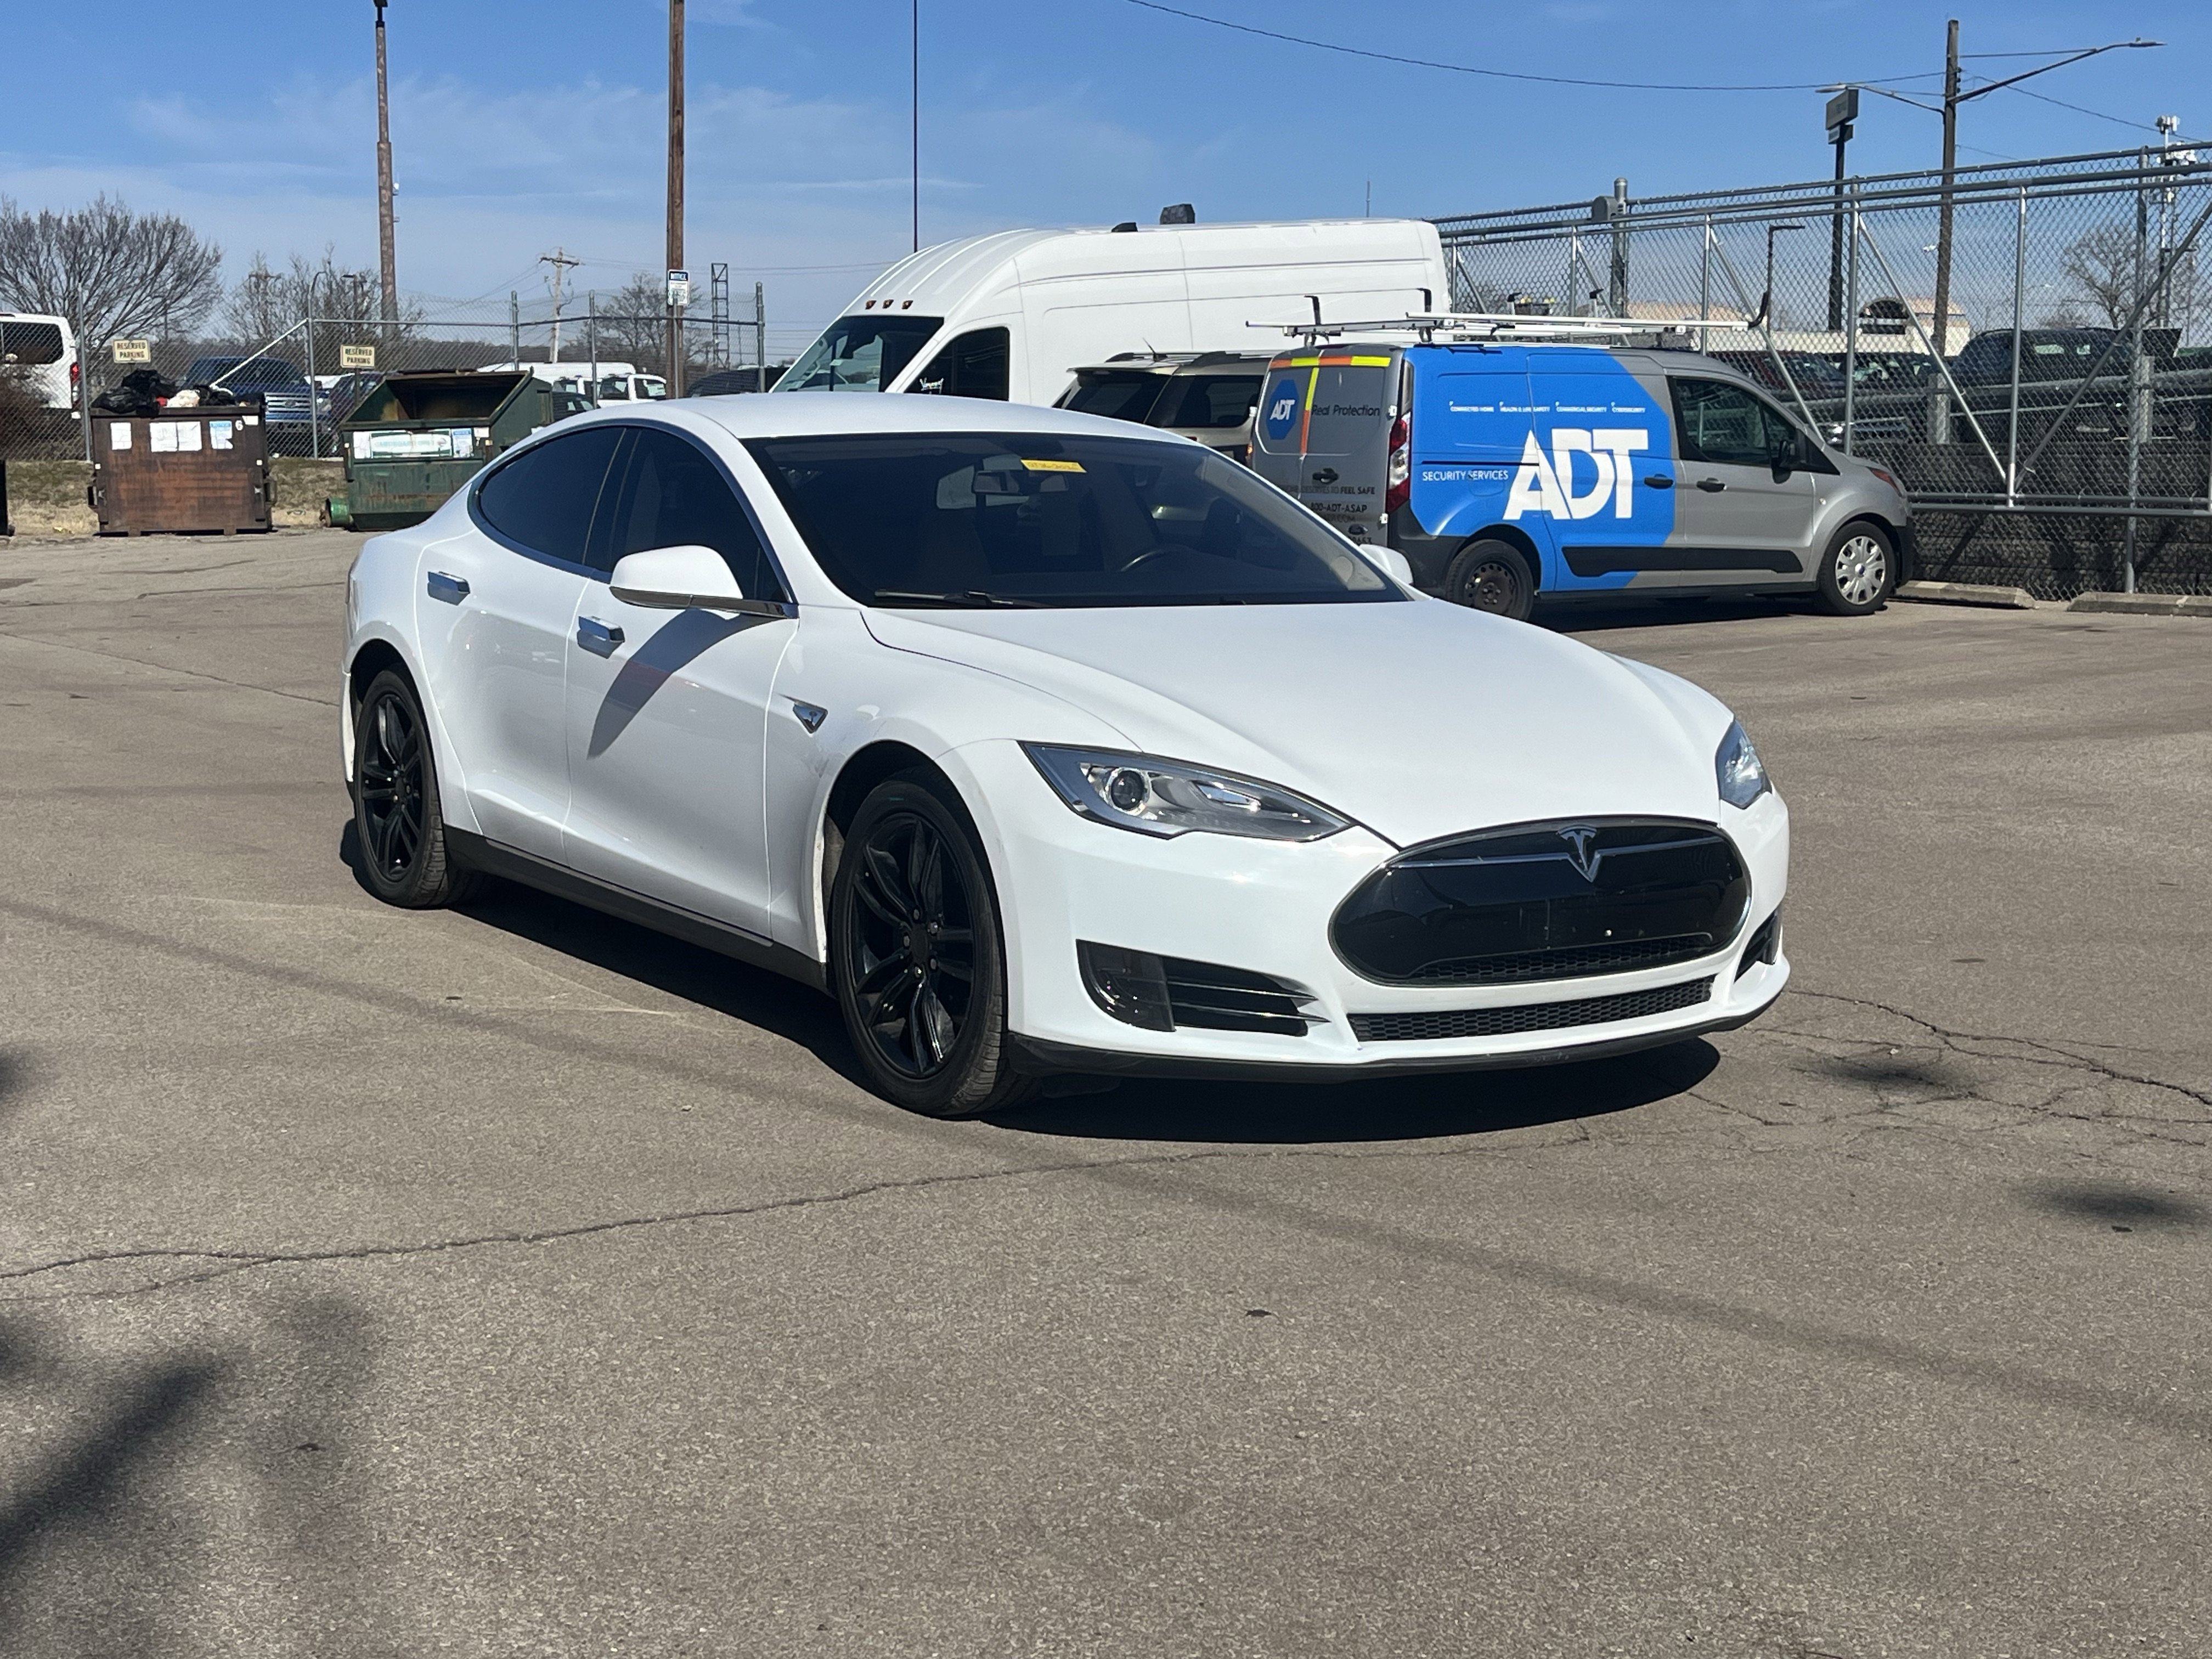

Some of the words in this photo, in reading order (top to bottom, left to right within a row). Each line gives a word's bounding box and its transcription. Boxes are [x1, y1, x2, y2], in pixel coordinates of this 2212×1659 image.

[1269, 399, 1296, 421] ADT
[1310, 405, 1330, 415] Real
[1333, 405, 1380, 416] Protection
[235, 420, 244, 431] 6
[1422, 471, 1466, 481] SECURITY
[1468, 470, 1509, 481] SERVICES
[1502, 428, 1649, 520] ADT
[1340, 486, 1356, 494] FEEL
[1357, 486, 1375, 495] SAFE
